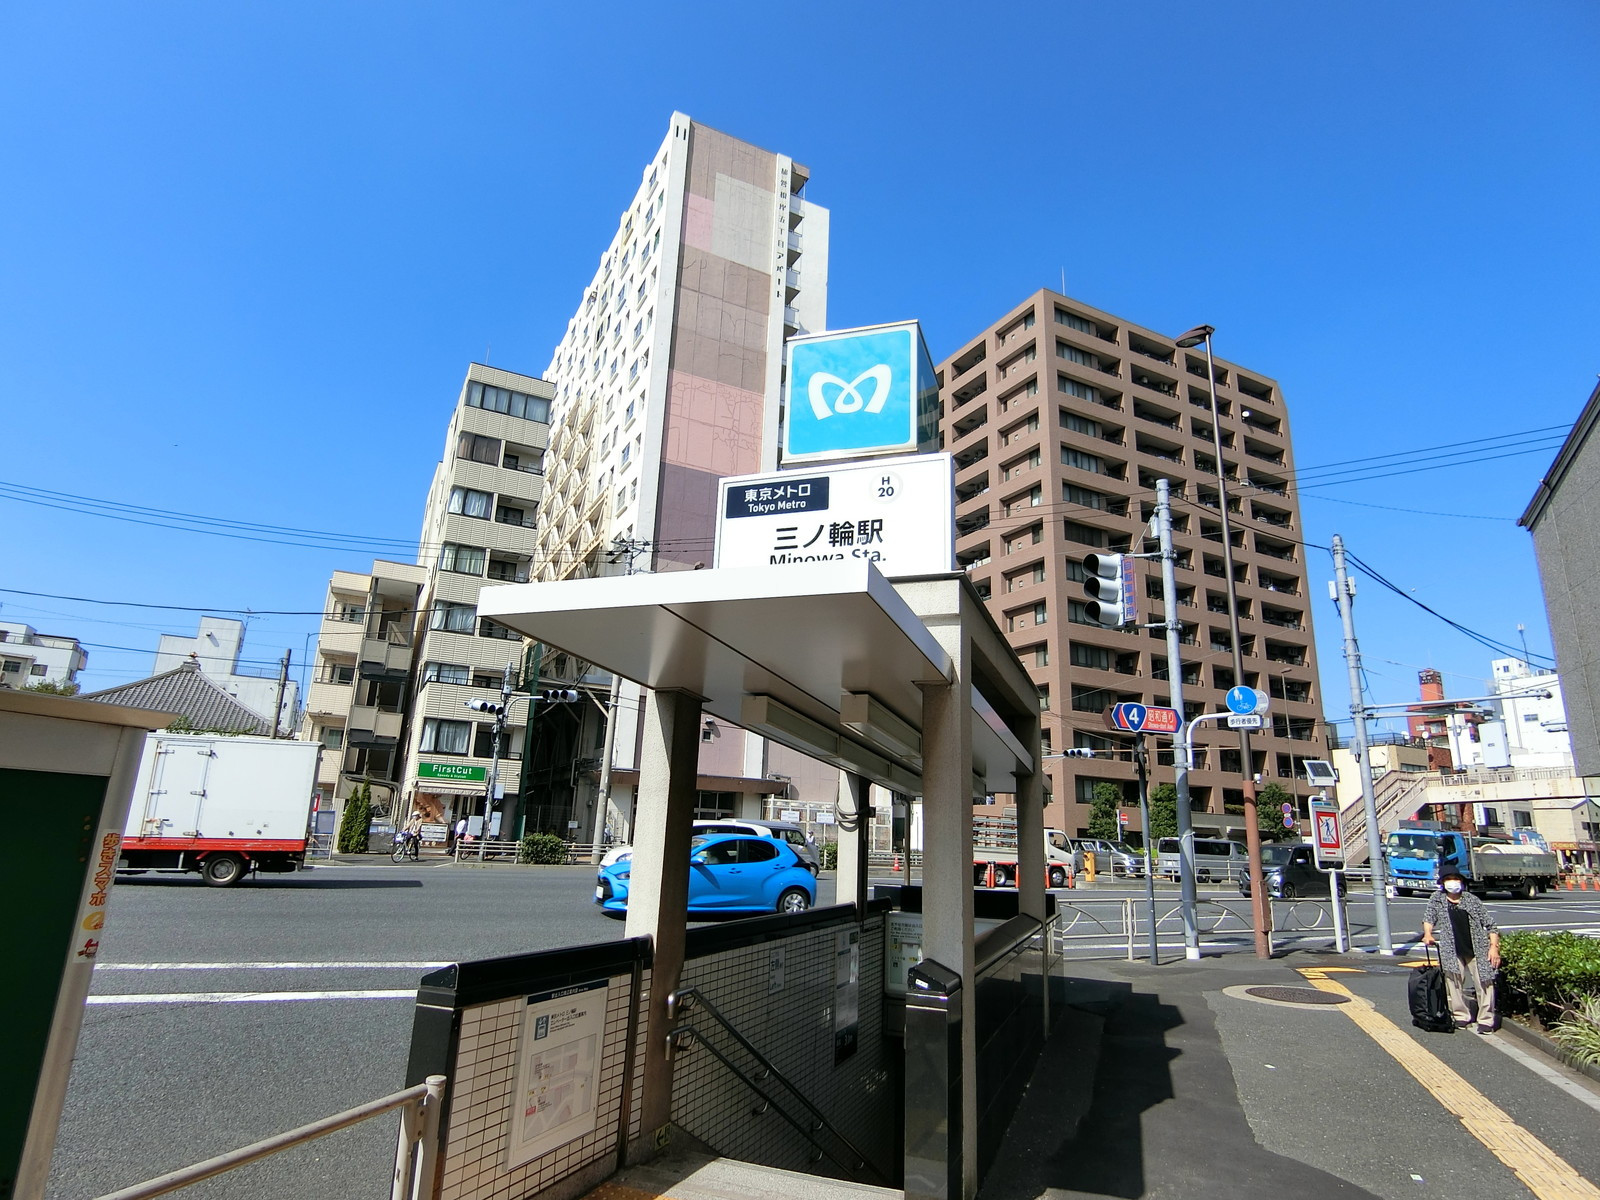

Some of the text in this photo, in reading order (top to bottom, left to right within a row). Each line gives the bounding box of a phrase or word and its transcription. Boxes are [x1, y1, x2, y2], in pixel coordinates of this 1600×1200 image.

[881, 476, 890, 486] H
[744, 483, 811, 503] 東京メトロ
[878, 486, 894, 498] 20
[748, 500, 806, 514] Tokyo Metro
[773, 518, 883, 550] 三ノ輪駅
[1128, 707, 1139, 725] 4
[1147, 709, 1174, 724] 昭和通り
[1230, 717, 1258, 725] 歩行者優先
[432, 764, 473, 775] FirstCut
[89, 832, 121, 906] 歩きスマホ
